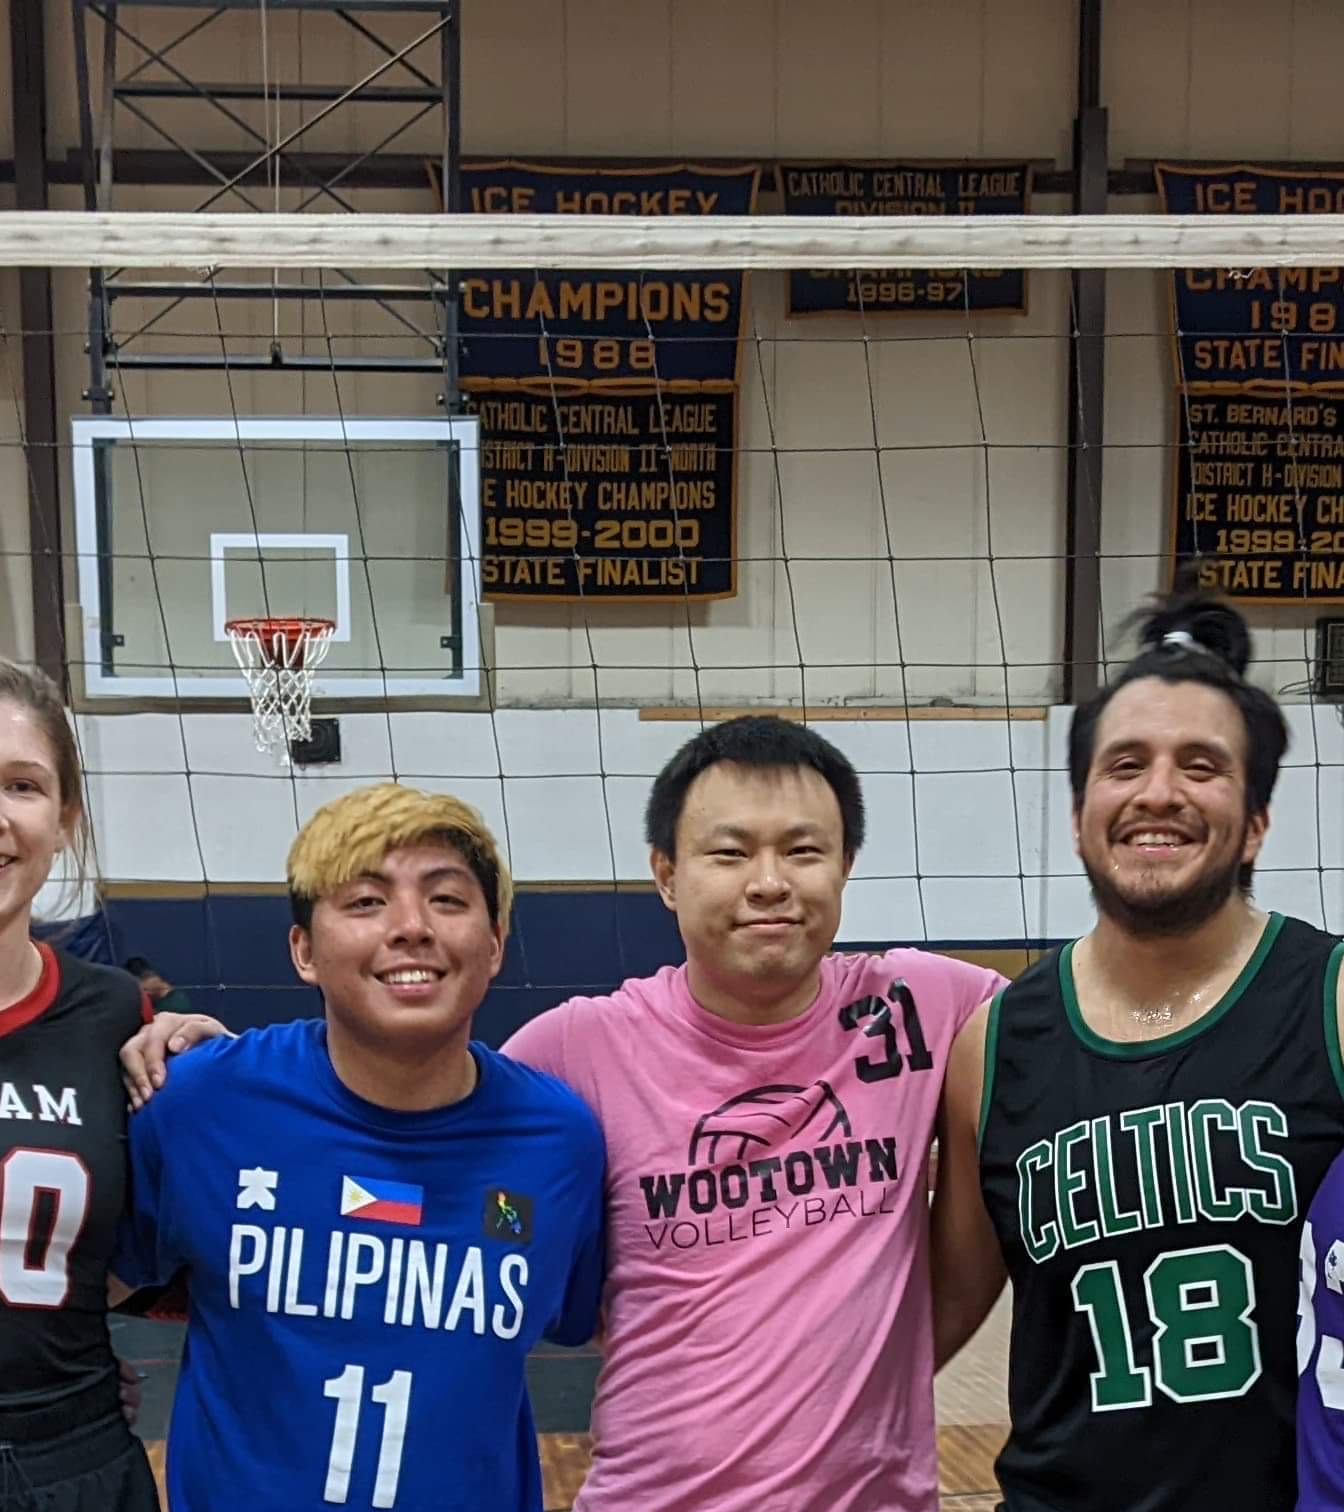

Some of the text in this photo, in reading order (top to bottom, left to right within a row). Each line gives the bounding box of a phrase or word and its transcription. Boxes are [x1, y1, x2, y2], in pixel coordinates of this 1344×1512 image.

[788, 172, 1020, 197] CATHOLIC CENTRAL LEAGUE
[1195, 182, 1256, 212] ICE
[471, 187, 718, 216] ICE HOCKEY
[464, 279, 730, 322] CHAMPIONS
[539, 337, 655, 369] 1988
[1195, 339, 1281, 370] STATE
[559, 404, 639, 434] CENTRAL
[650, 404, 717, 433] LEAGUE
[1227, 402, 1337, 427] BERNARD'S
[1189, 431, 1267, 457] CATHOLIC
[1193, 462, 1254, 487] DISTRICT
[507, 480, 587, 510] HOCKEY
[598, 480, 715, 510] CHAMPIONS
[1186, 493, 1217, 521] ICE
[1227, 495, 1308, 523] HOCKEY
[485, 518, 700, 548] 1999-2000
[482, 556, 702, 586] STATE FINALIST
[1198, 560, 1282, 589] STATE
[838, 977, 933, 1083] 31
[639, 1137, 898, 1220] WOOTOWN
[1016, 1098, 1298, 1264] CELTICS
[645, 1188, 895, 1250] VOLLEYBALL
[229, 1224, 528, 1340] PILIPINAS
[1071, 1244, 1262, 1413] 18
[323, 1364, 413, 1508] 11
